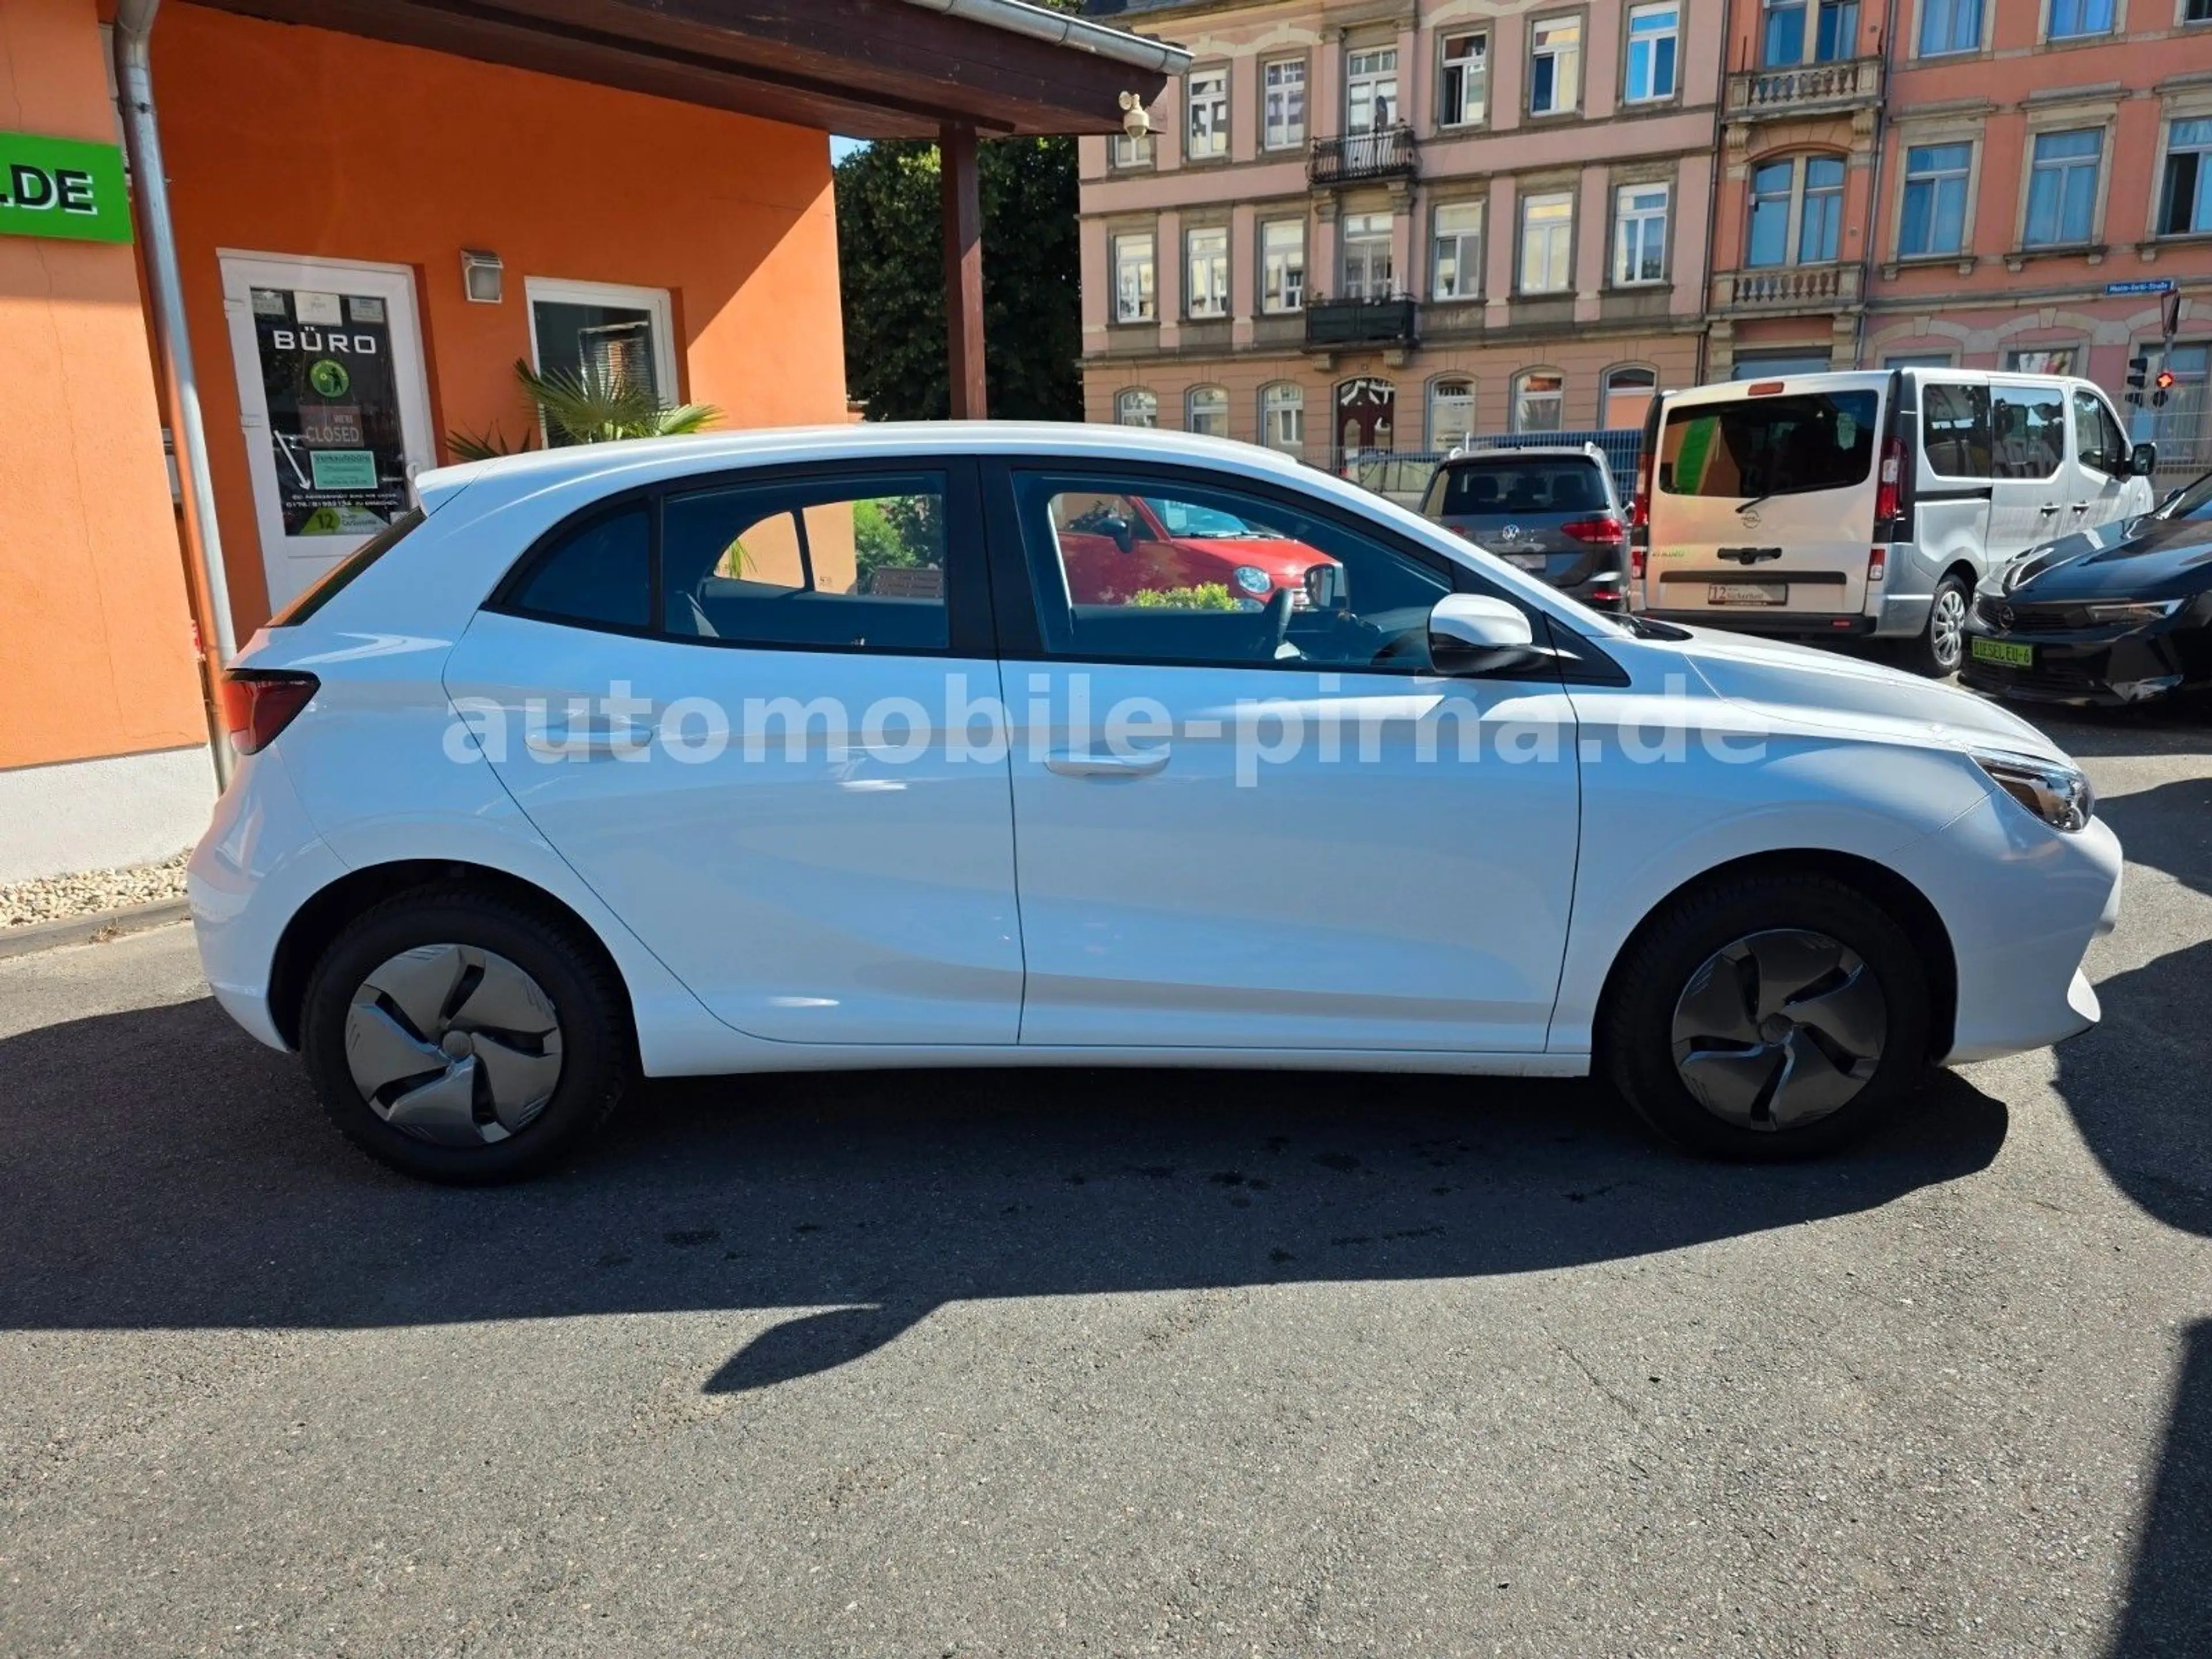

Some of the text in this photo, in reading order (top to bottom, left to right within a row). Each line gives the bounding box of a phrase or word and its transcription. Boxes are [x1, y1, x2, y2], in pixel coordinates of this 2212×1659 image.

[273, 326, 377, 354] BÜRO
[305, 425, 359, 443] CLOSED
[316, 513, 335, 529] 12
[1712, 585, 1726, 600] 12
